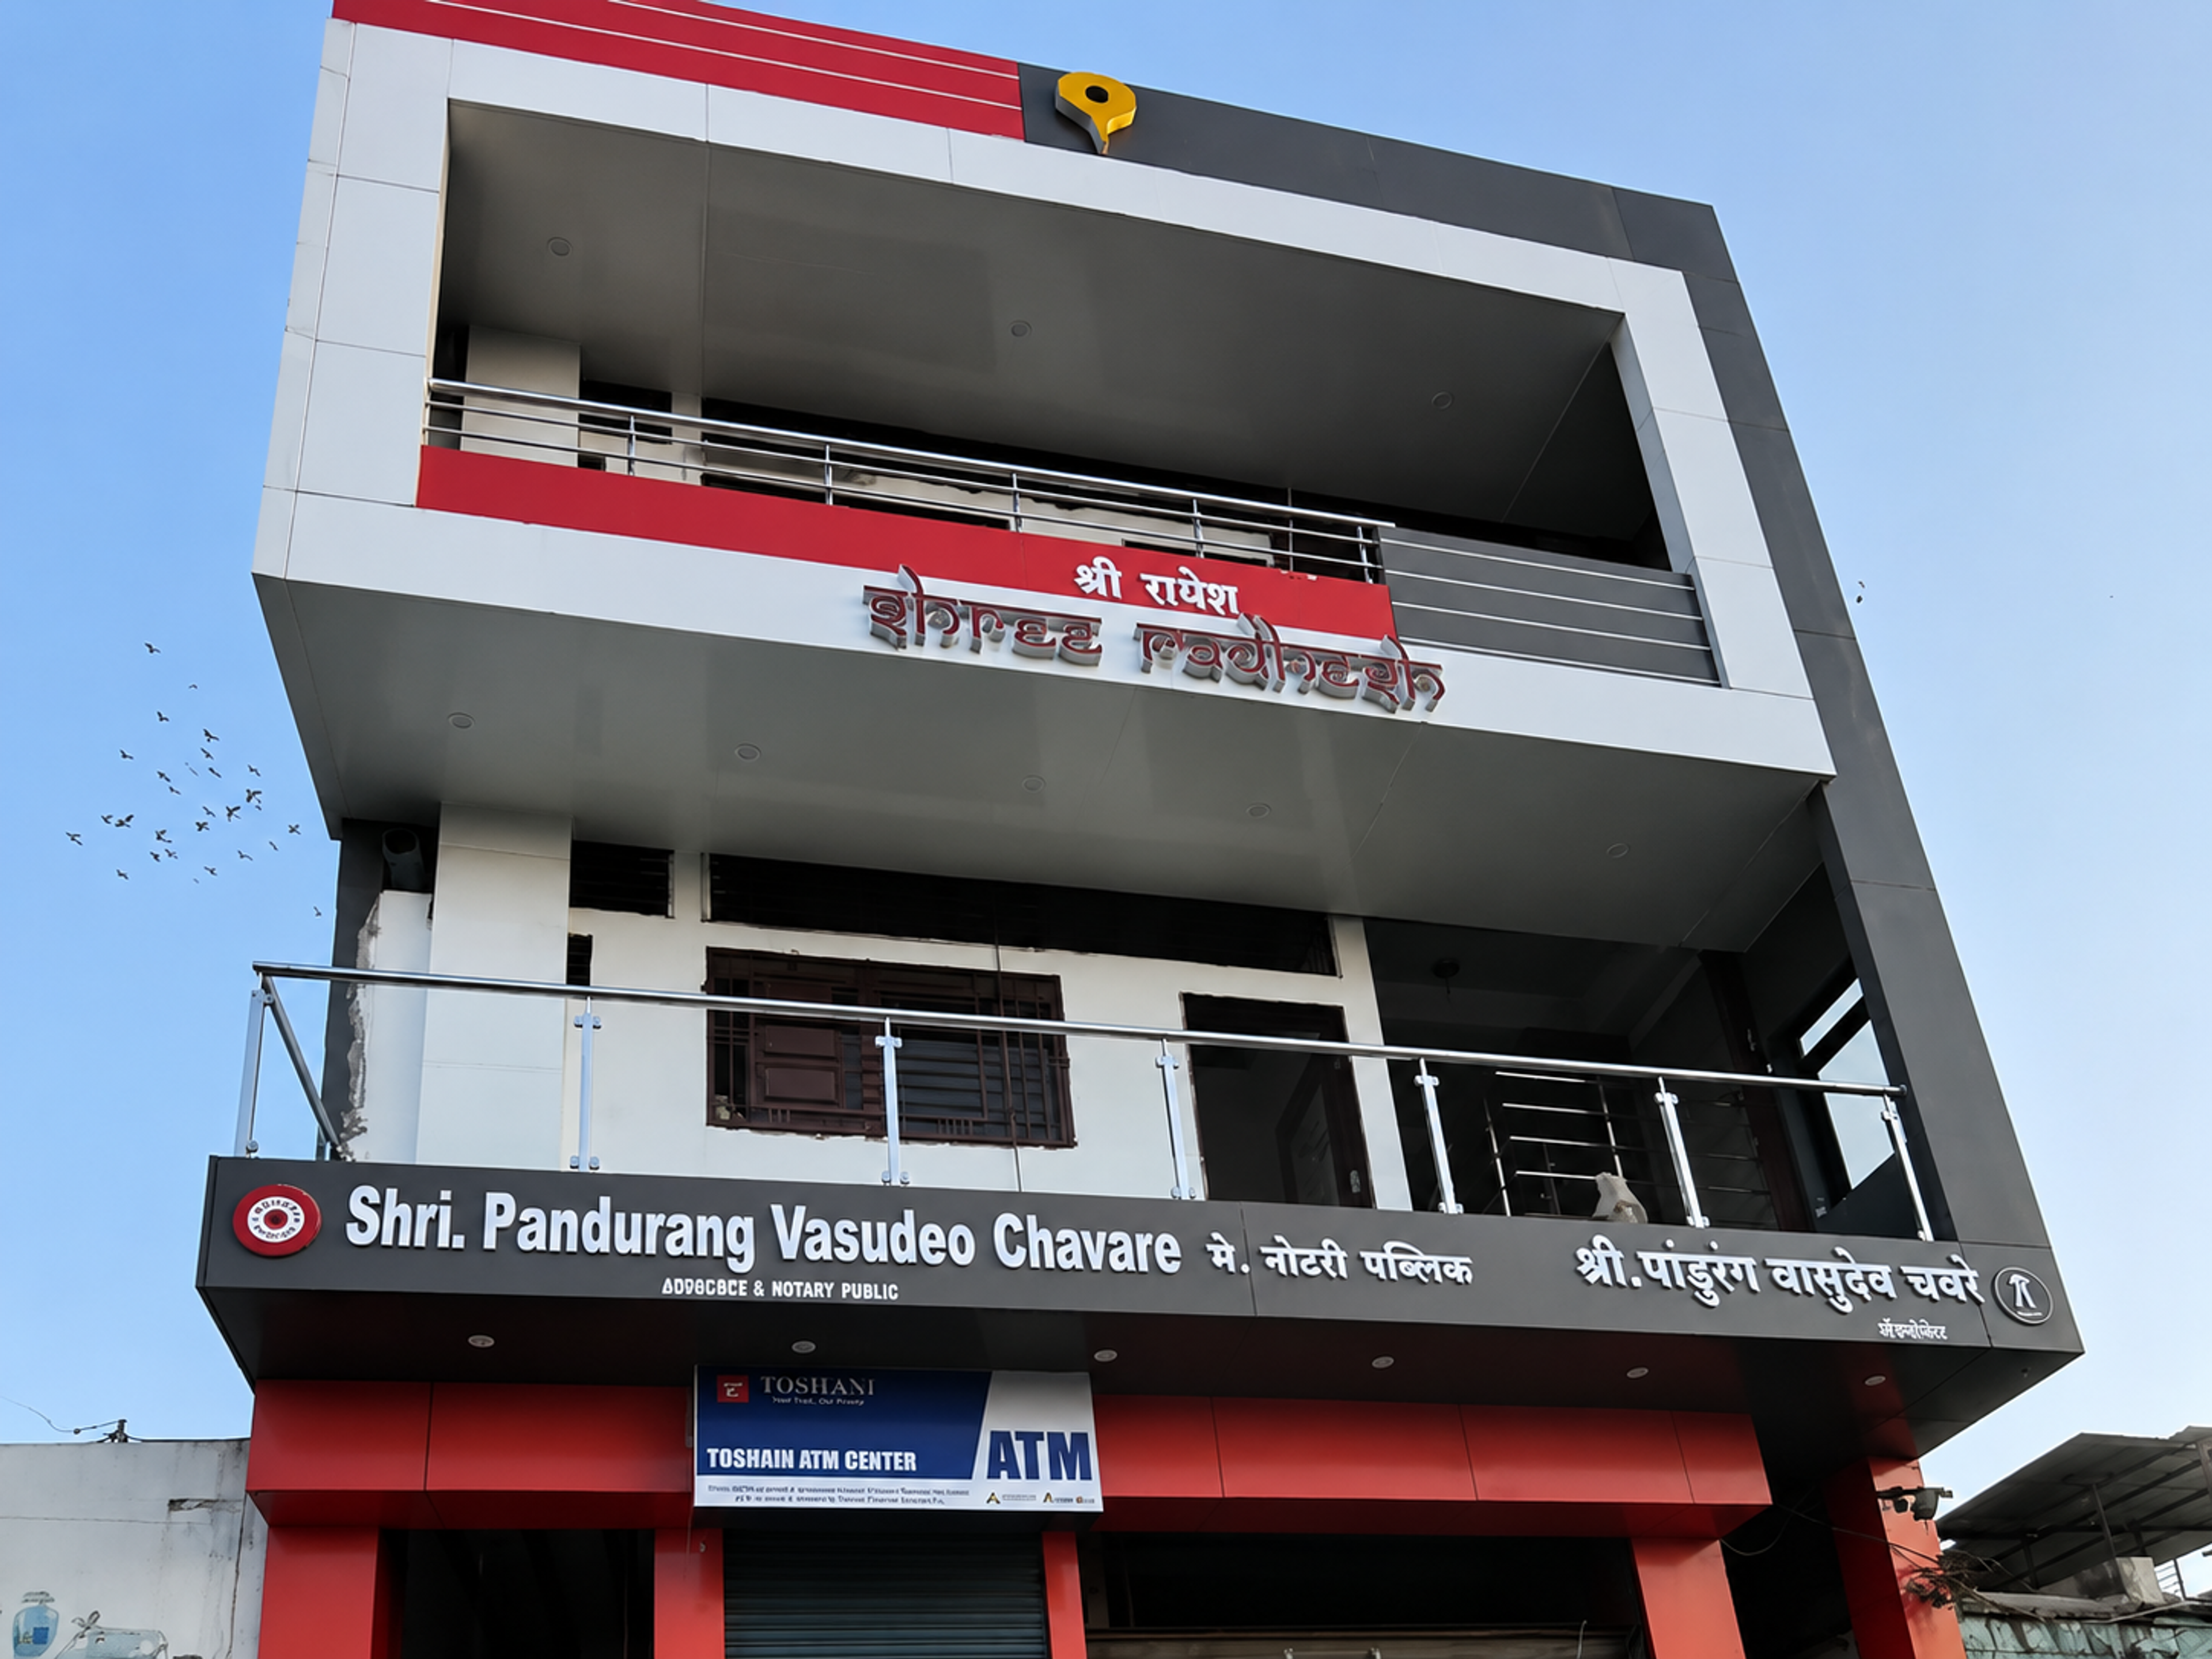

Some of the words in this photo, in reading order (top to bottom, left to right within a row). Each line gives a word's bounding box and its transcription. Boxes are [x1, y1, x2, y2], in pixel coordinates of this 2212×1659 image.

[1074, 555, 1122, 599] श्री
[346, 1184, 465, 1249] Shri.
[483, 1191, 755, 1274] Pandurang
[770, 1203, 976, 1266] Vasudeo
[993, 1212, 1182, 1274] Chavare
[1259, 1234, 1349, 1279] नोटरी
[1359, 1240, 1474, 1284] पब्लिक
[1764, 1246, 1897, 1313] वासुदेव
[1900, 1253, 1986, 1304] चवरे
[753, 1279, 765, 1297] &
[772, 1280, 835, 1298] NOTARY
[842, 1282, 899, 1300] PUBLIC
[761, 1376, 874, 1396] TOSHANI
[707, 1448, 794, 1469] TOSHAIN
[799, 1449, 839, 1470] ATM
[844, 1450, 917, 1472] CENTER
[987, 1430, 1093, 1481] ATM
